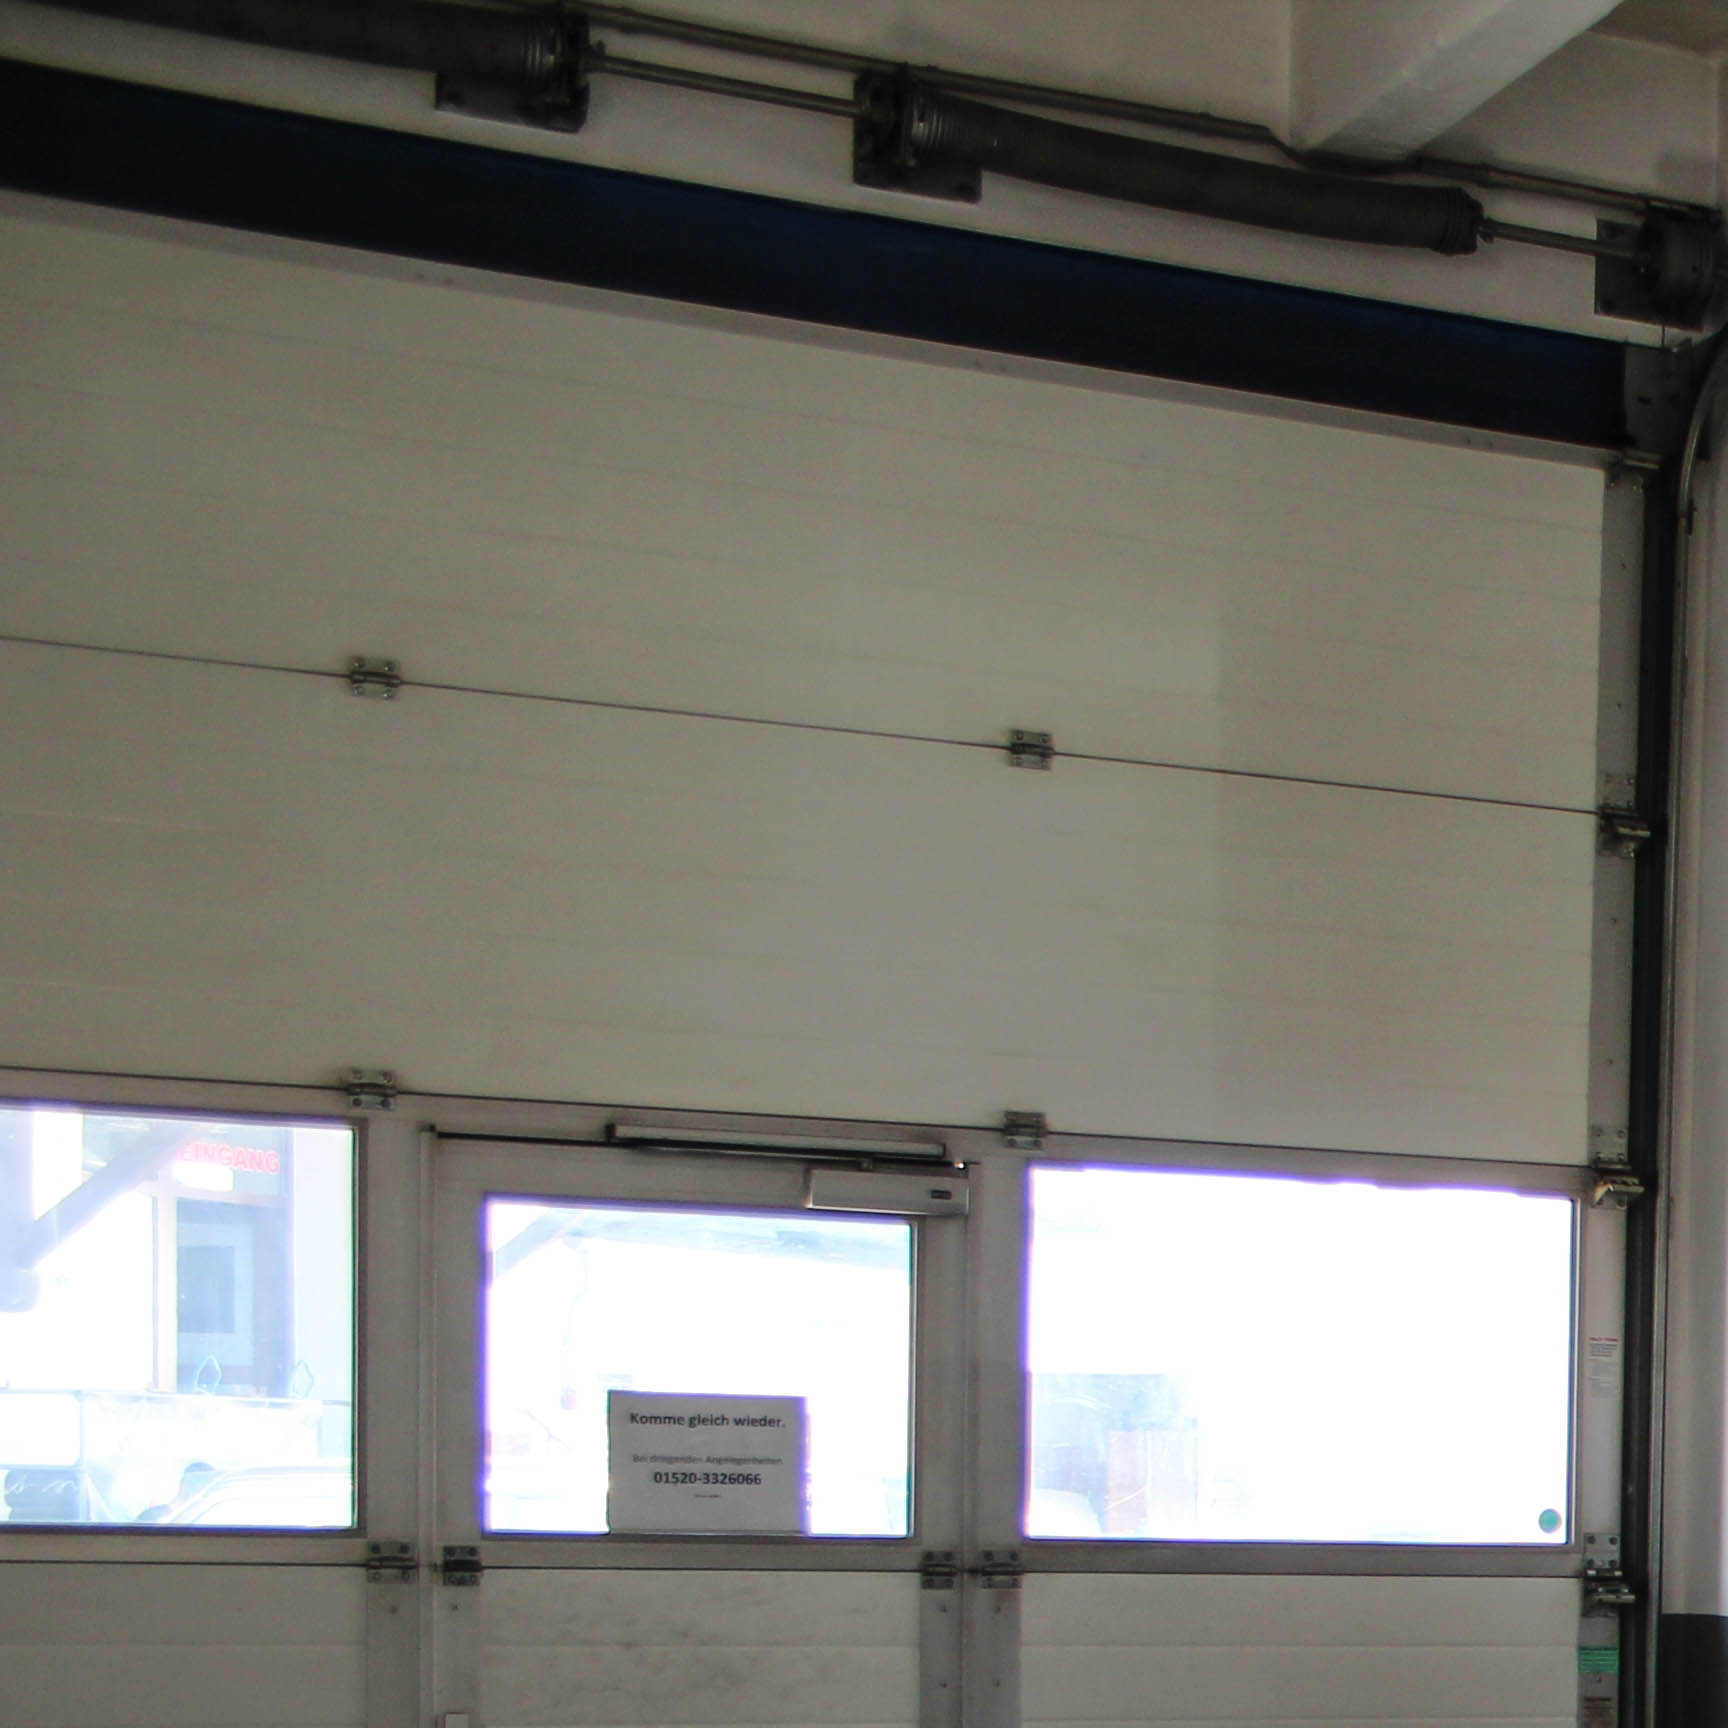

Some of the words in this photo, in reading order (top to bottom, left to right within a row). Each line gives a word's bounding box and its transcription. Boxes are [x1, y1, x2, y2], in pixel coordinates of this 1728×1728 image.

[178, 1143, 280, 1174] EINGANG
[630, 1413, 685, 1425] Komme
[689, 1414, 729, 1428] gleich
[734, 1416, 787, 1428] wieder.
[654, 1472, 763, 1485] 01520-3326066
